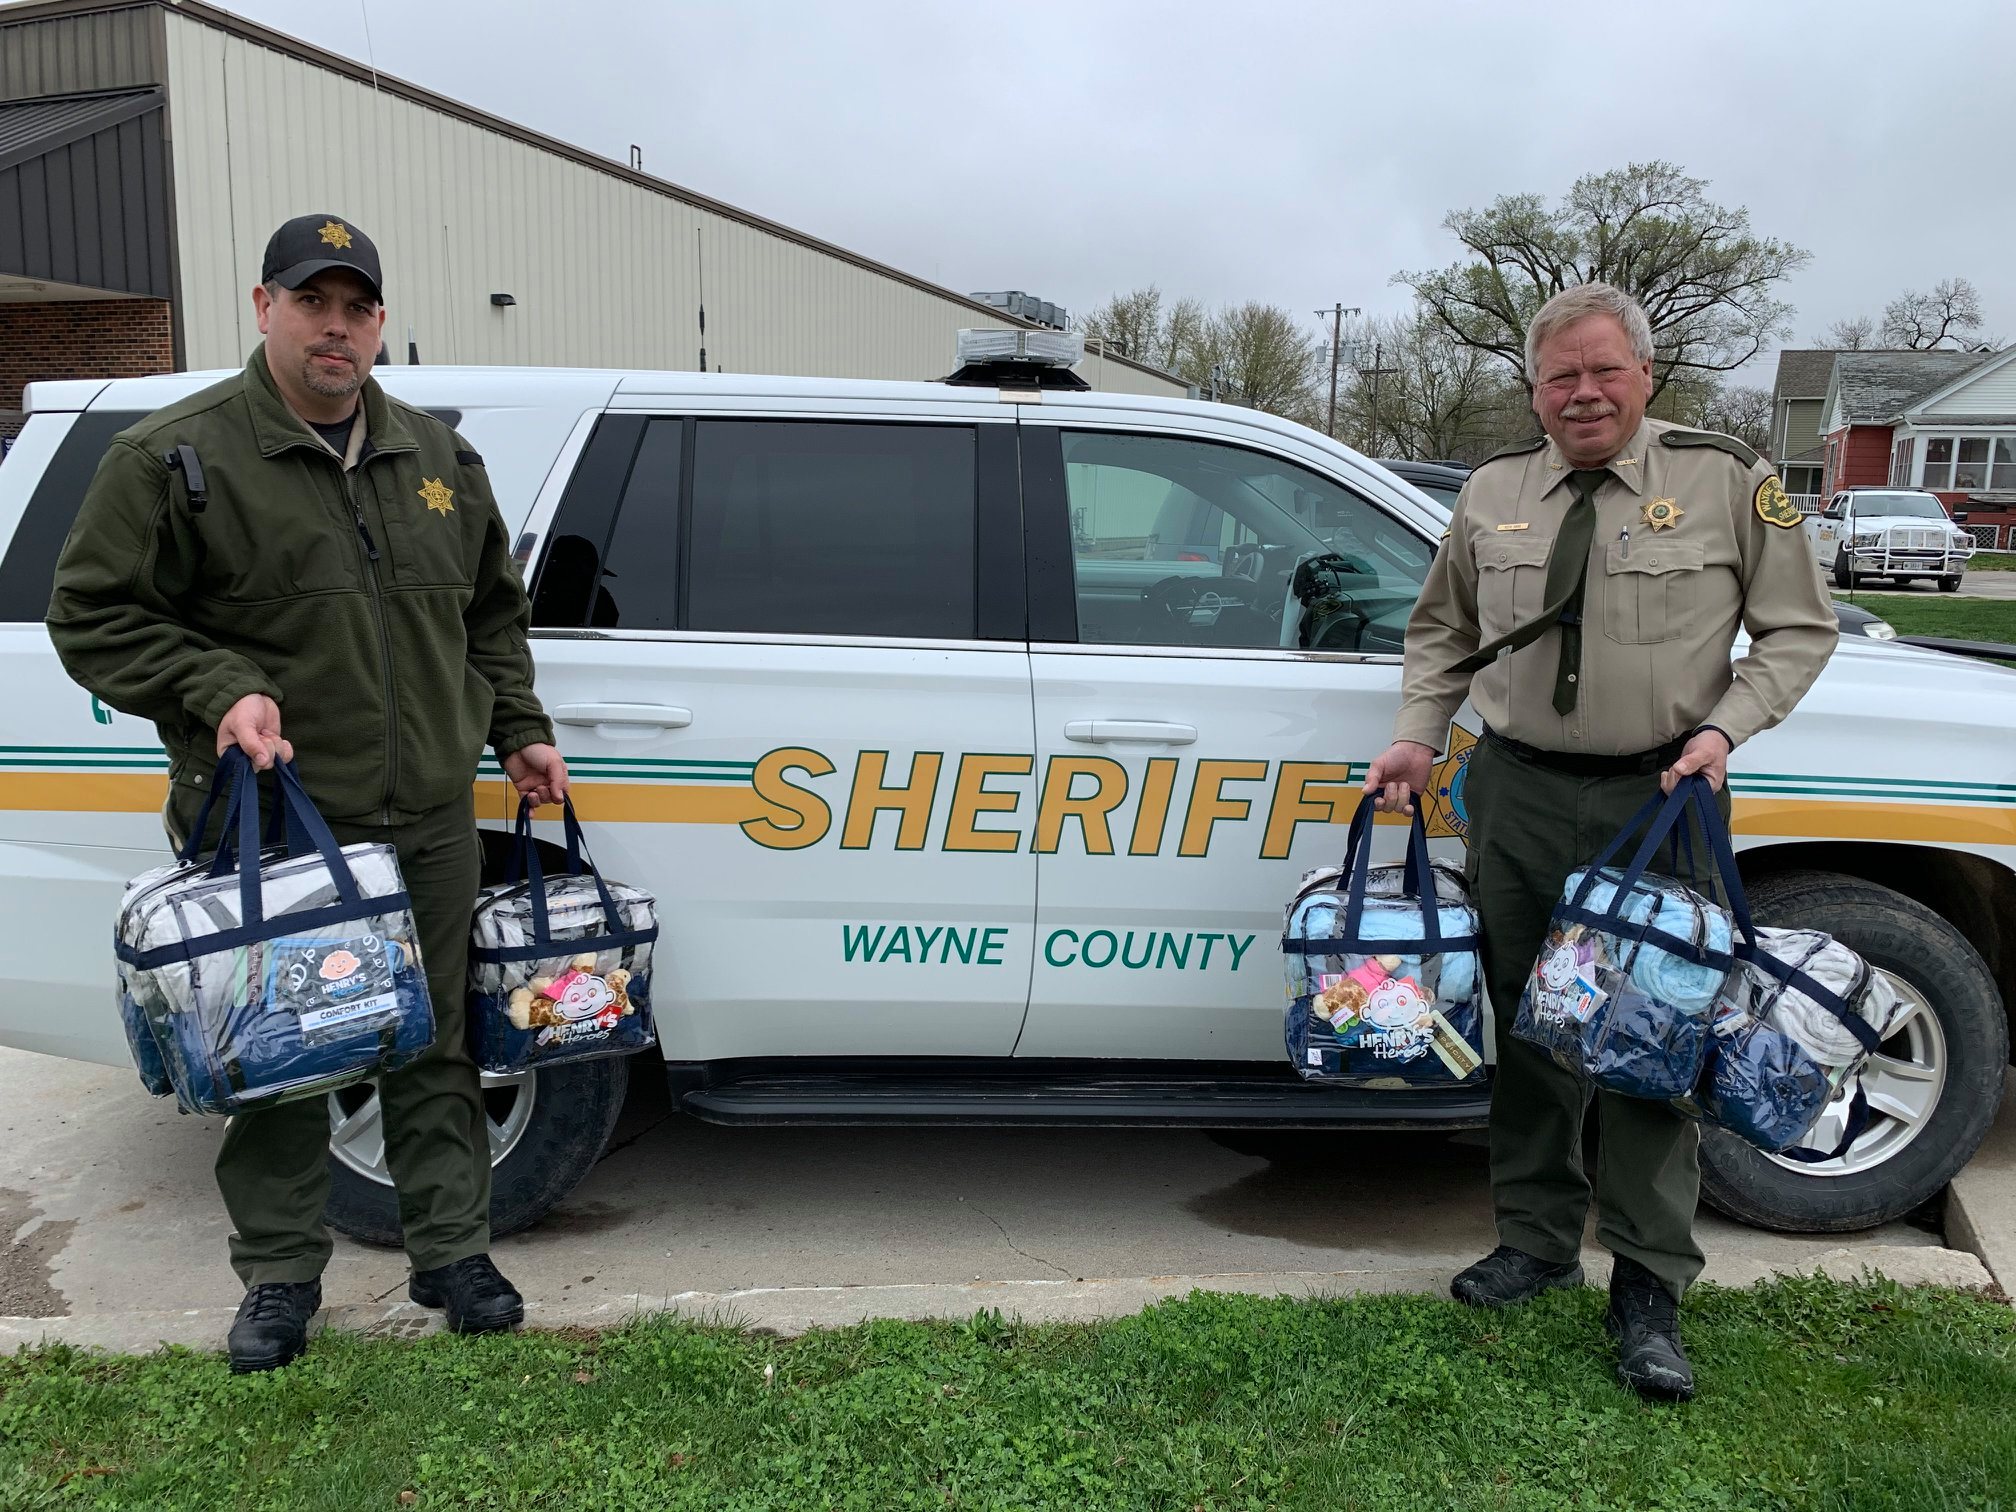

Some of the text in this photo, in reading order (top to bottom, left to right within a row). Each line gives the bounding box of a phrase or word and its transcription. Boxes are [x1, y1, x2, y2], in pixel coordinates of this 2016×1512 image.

[1761, 484, 1774, 512] WAYNE
[739, 746, 1351, 860] SHERIFF
[843, 925, 1256, 971] WAYNE COUNTY
[321, 973, 367, 994] HENRY'S
[320, 1003, 361, 1020] COMFORT
[364, 999, 379, 1009] KIT
[549, 1011, 618, 1038] HENRY'S
[559, 1028, 612, 1045] Heroes
[1359, 1027, 1435, 1048] HENRY'S
